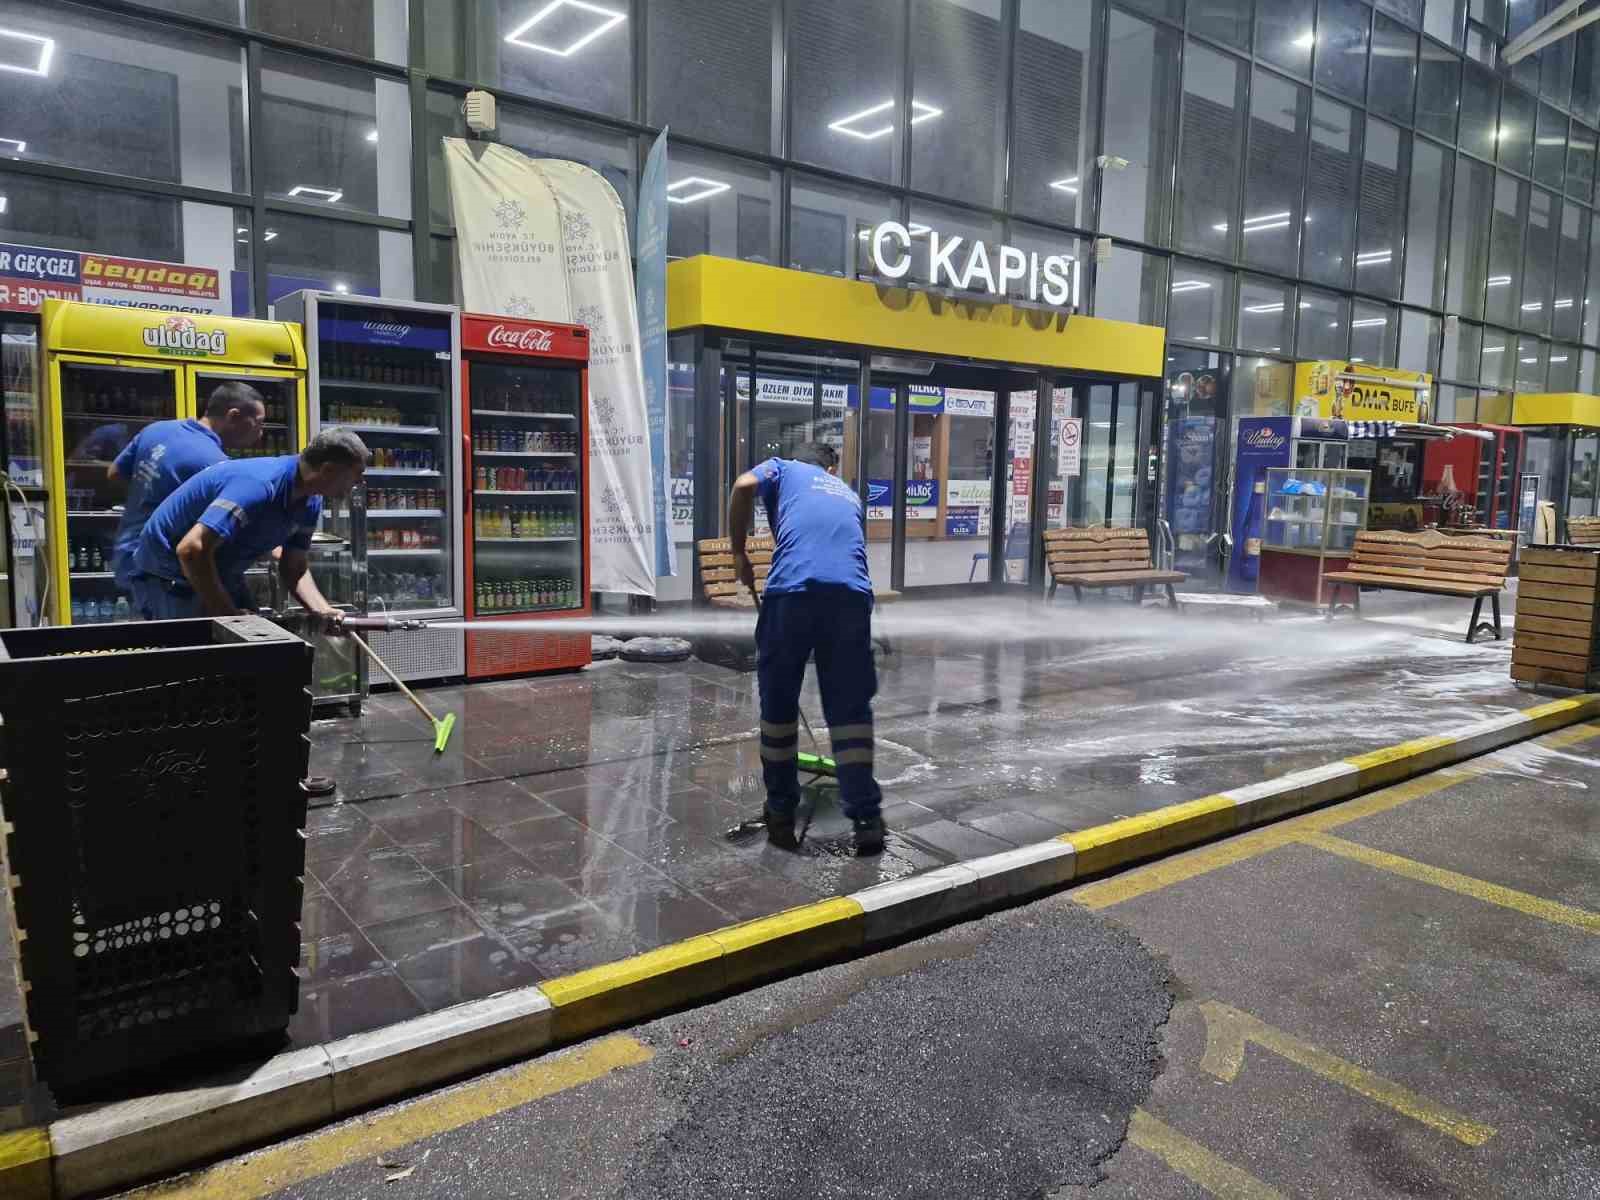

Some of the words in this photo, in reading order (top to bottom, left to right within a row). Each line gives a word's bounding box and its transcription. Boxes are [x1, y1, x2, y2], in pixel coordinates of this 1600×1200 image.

[14, 254, 76, 278] GEÇGEL
[82, 257, 217, 290] beydağı
[872, 221, 912, 278] C
[929, 231, 1081, 308] KAPISI
[143, 323, 226, 355] uludağ
[487, 324, 554, 352] Coca-Cola
